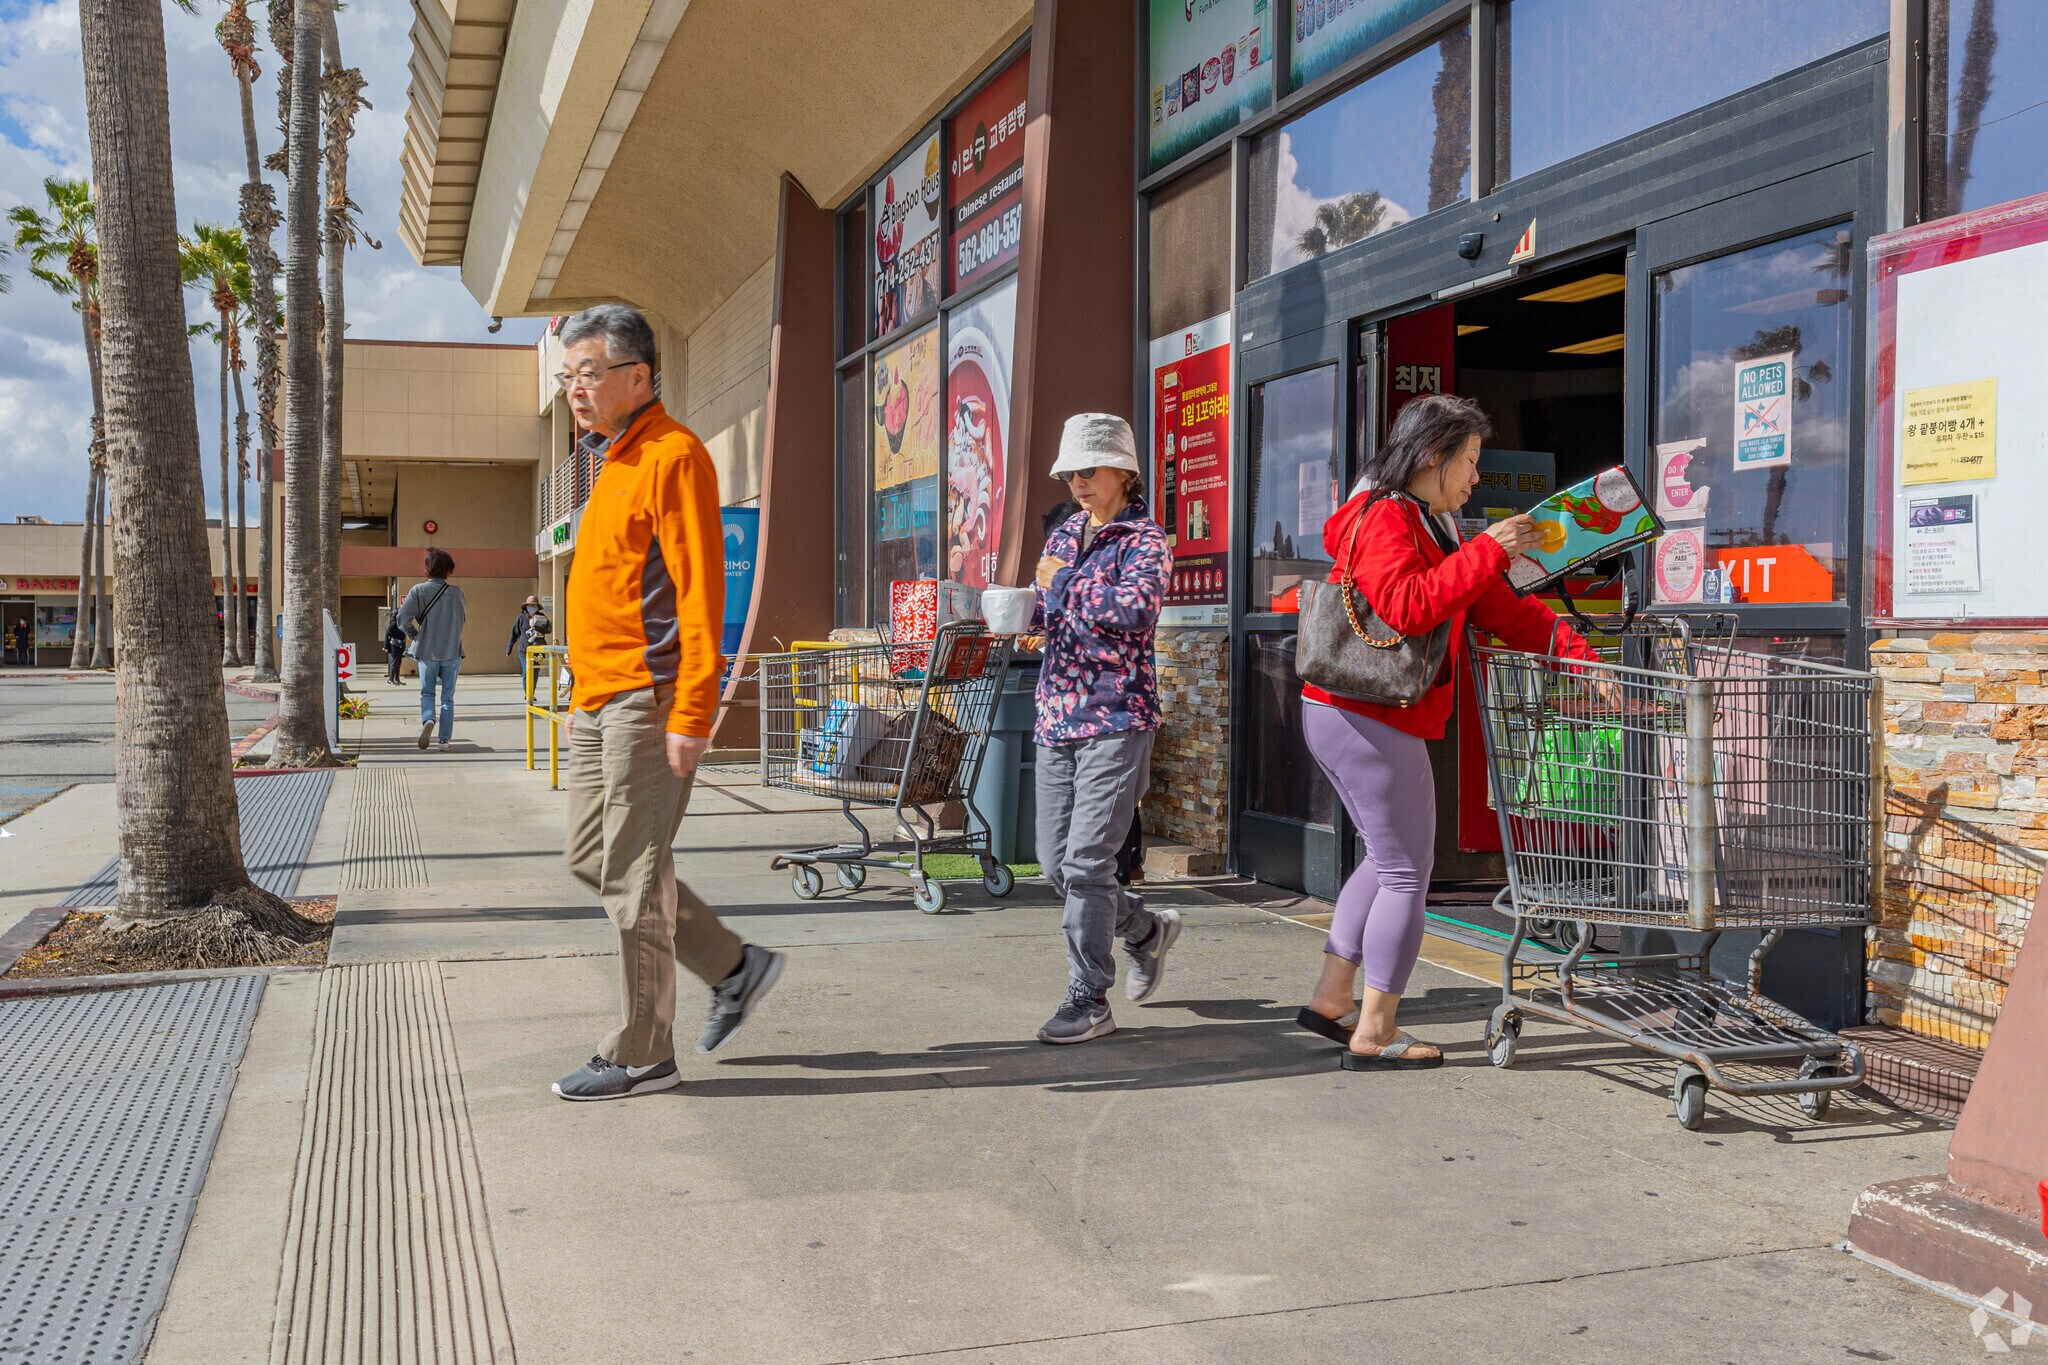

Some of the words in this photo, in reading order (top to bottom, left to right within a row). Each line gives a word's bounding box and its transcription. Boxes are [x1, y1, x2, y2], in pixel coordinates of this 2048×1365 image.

[989, 100, 1026, 150] 교동짬뽕
[891, 188, 919, 226] BingSoo
[921, 170, 939, 201] Hous
[958, 192, 988, 222] Chinese
[989, 165, 1024, 201] restaura
[958, 202, 1022, 277] 562-860-552
[877, 234, 940, 299] 714-252-437
[1395, 365, 1441, 395] 최저
[1743, 371, 1756, 385] NO
[1759, 365, 1782, 381] PETS
[1742, 380, 1783, 399] ALLOWED
[1182, 402, 1194, 427] 1일
[1196, 393, 1229, 423] 1포하라!
[1908, 424, 1917, 437] 왕
[1920, 418, 1957, 436] 팥붕어빵
[1959, 416, 1976, 430] 4개
[1974, 431, 1985, 439] $15
[1667, 465, 1677, 475] DO
[1517, 473, 1546, 493] 플랜
[1671, 488, 1689, 498] ENTER
[890, 488, 929, 538] Taiyaki
[723, 560, 751, 570] RIMO
[1717, 557, 1777, 594] XIT
[16, 578, 80, 590] BAKER
